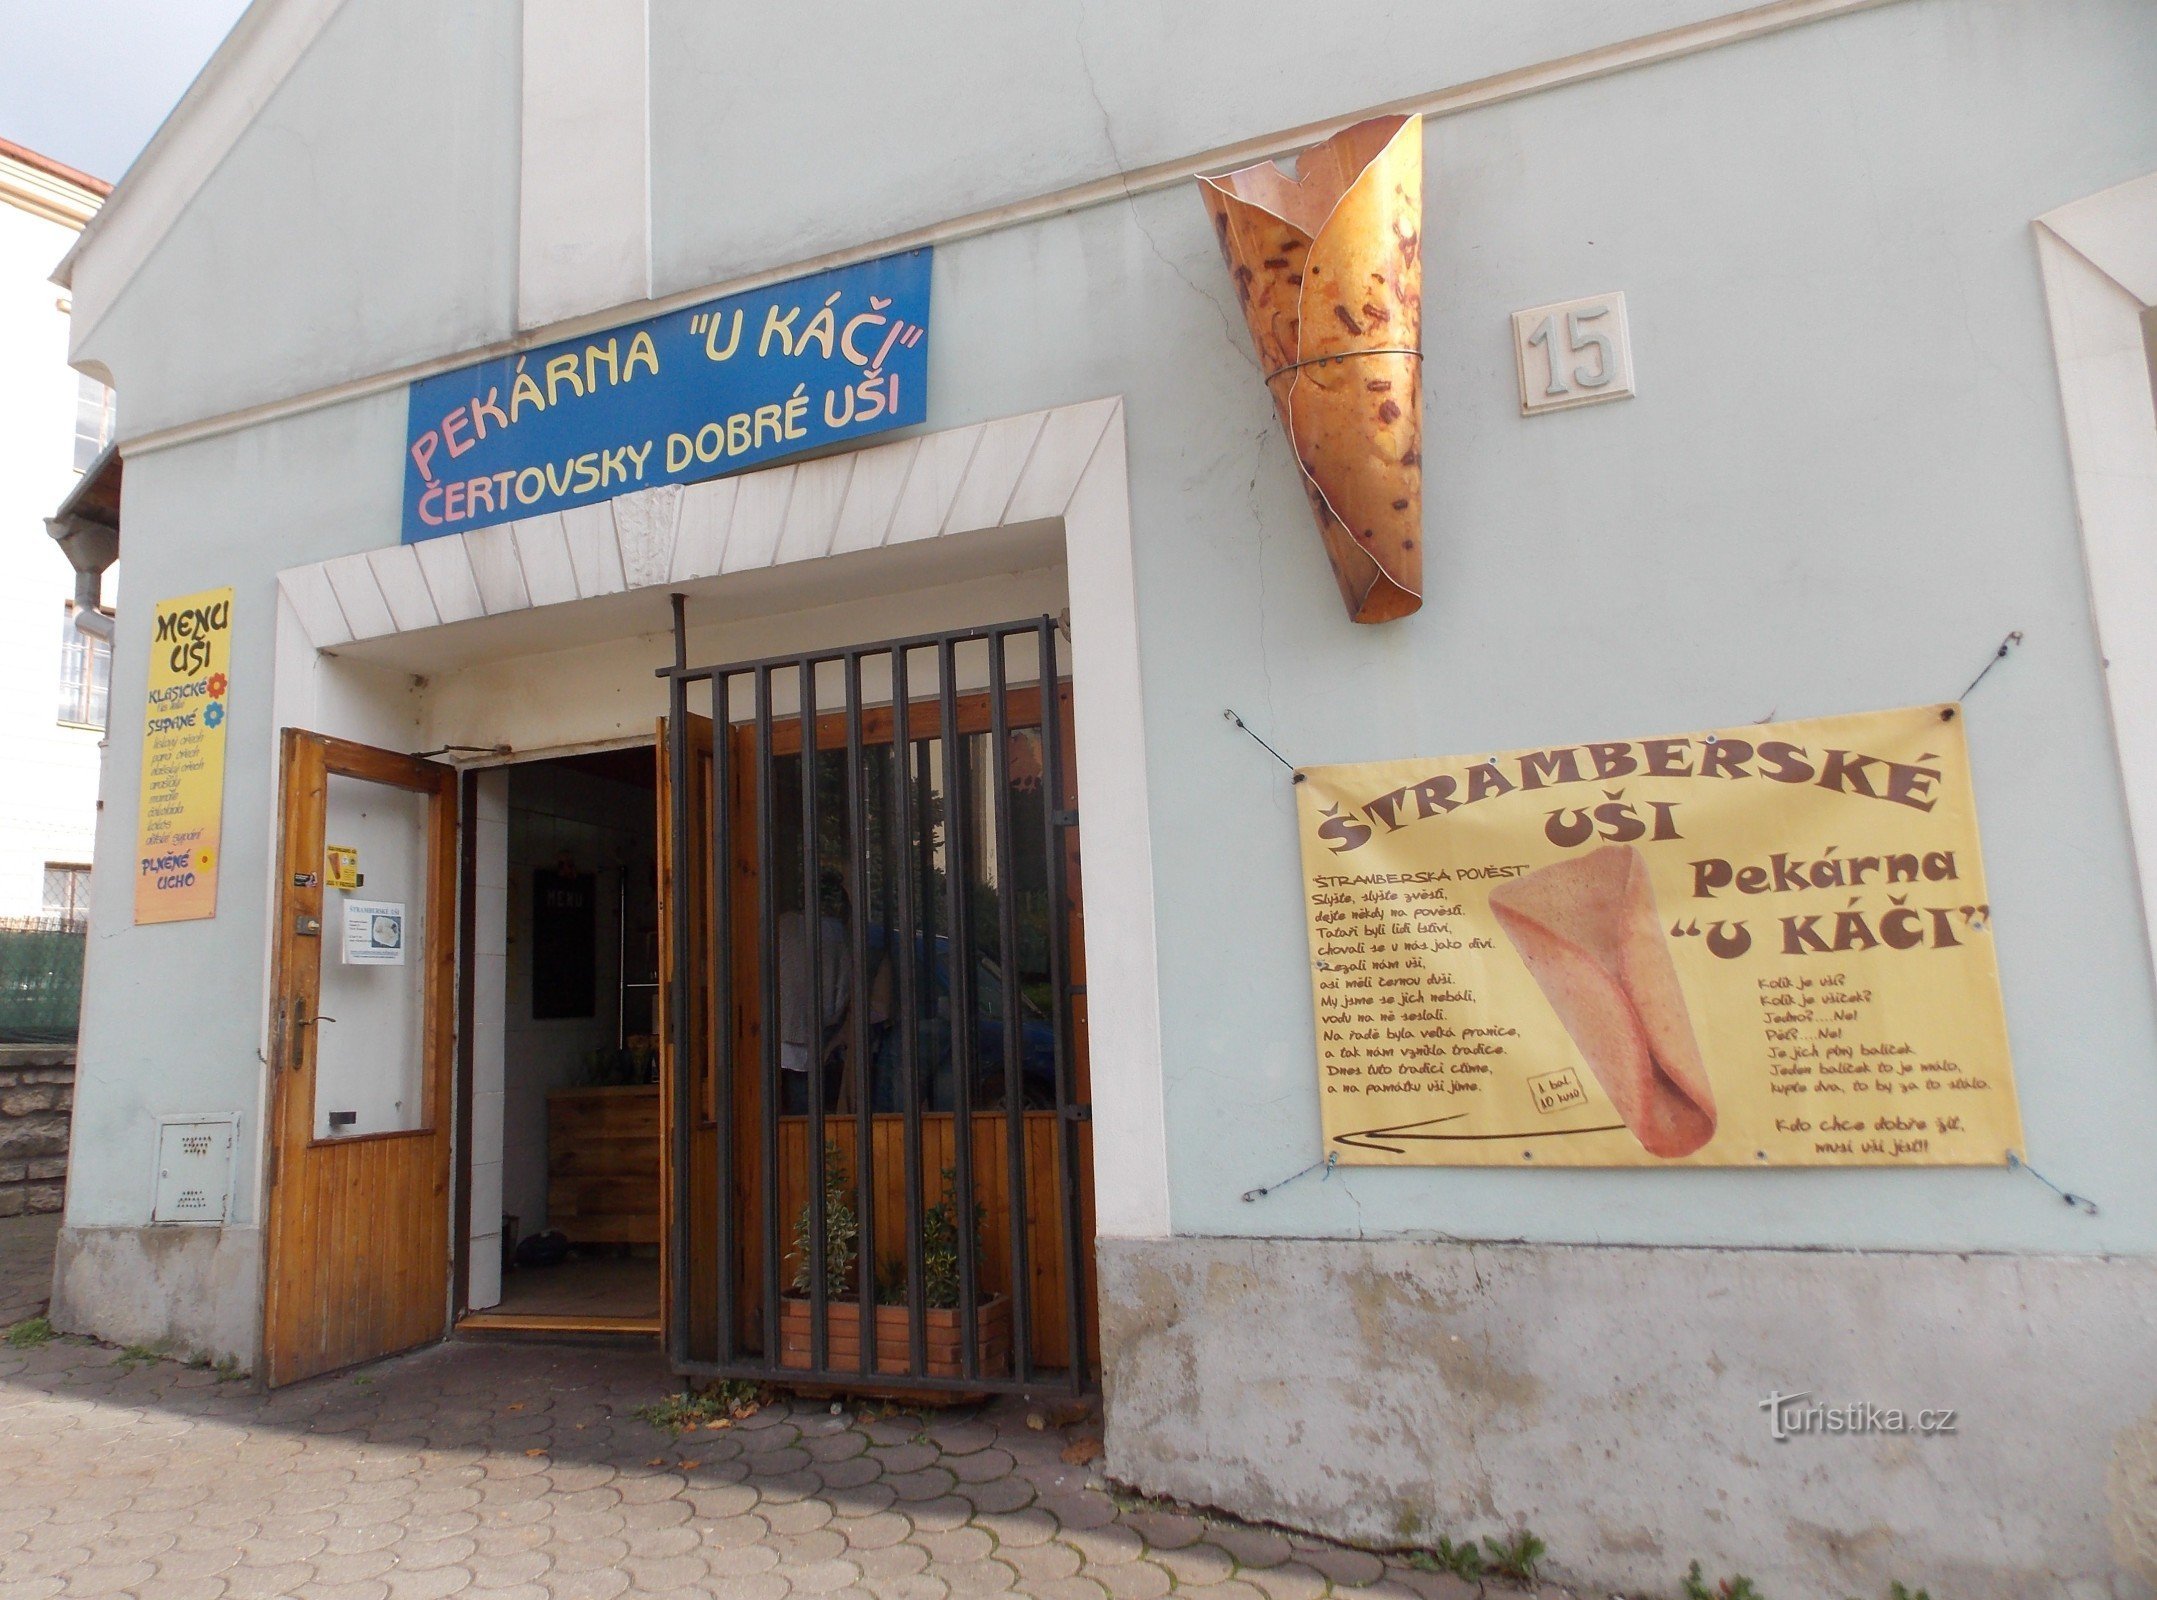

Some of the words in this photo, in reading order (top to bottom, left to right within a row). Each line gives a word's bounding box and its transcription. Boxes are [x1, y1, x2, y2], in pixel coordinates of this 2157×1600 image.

[1528, 304, 1615, 394] 15
[411, 331, 659, 481] PEKÁRNA
[690, 308, 743, 361] "U
[758, 291, 924, 370] KÁČI"
[418, 440, 653, 525] ČERTOVSKY
[666, 383, 809, 473] DOBRÉ
[824, 367, 899, 428] UŠI
[155, 600, 229, 643] MENU
[170, 634, 211, 676] UŠI
[149, 677, 207, 704] KLASICKÉ
[147, 708, 198, 736] SYPANÉ
[1317, 738, 1941, 856] ŠTRAMBERSKÉ
[1543, 788, 1685, 848] UŠI
[142, 849, 190, 875] PLNĚNÉ
[157, 872, 196, 890] UCHO
[1688, 846, 1959, 898] Pekárna
[1311, 893, 1355, 907] Slyšte,
[1361, 890, 1398, 903] slyšte
[1315, 910, 1346, 924] dejte
[1351, 907, 1384, 920] někdy
[1391, 908, 1407, 917] na
[1414, 904, 1466, 919] pověsti.
[1316, 926, 1358, 938] Tataři
[1364, 924, 1386, 938] byli
[1670, 918, 1751, 959] “U
[1778, 893, 1989, 956] KÁČI”
[1318, 942, 1365, 956] chovali
[1370, 944, 1386, 953] se
[1391, 943, 1398, 951] u
[1404, 941, 1428, 951] nás
[1431, 938, 1462, 952] jako
[1372, 959, 1399, 970] nám
[1405, 957, 1425, 969] uši,
[1320, 978, 1339, 989] asi
[1345, 976, 1372, 988] měli
[1378, 976, 1420, 987] černou
[1427, 973, 1455, 985] duši.
[1758, 976, 1793, 989] Kolik
[1796, 976, 1813, 990] je
[1321, 995, 1338, 1009] My
[1341, 994, 1374, 1009] jsme
[1379, 996, 1395, 1005] se
[1398, 990, 1424, 1006] jich
[1430, 989, 1476, 1003] nebáli,
[1760, 994, 1795, 1006] Kolik
[1798, 993, 1815, 1007] je
[1322, 1012, 1351, 1023] vodu
[1357, 1013, 1374, 1022] na
[1380, 1010, 1395, 1021] ně
[1400, 1009, 1447, 1021] seslali.
[1323, 1030, 1343, 1041] Na
[1386, 1027, 1414, 1041] byla
[1420, 1026, 1456, 1038] velká
[1462, 1025, 1520, 1040] pranice,
[1325, 1050, 1335, 1058] a
[1340, 1046, 1361, 1057] tak
[1366, 1046, 1394, 1057] nám
[1400, 1044, 1447, 1059] vznikla
[1452, 1043, 1508, 1055] tradice.
[1767, 1047, 1787, 1058] Je
[1789, 1043, 1819, 1061] jich
[1326, 1065, 1362, 1076] Dnes
[1367, 1064, 1392, 1074] tuto
[1398, 1062, 1444, 1075] tradici
[1769, 1063, 1812, 1076] Jeden
[1878, 1062, 1893, 1073] to
[1897, 1060, 1914, 1076] je
[1327, 1085, 1337, 1093] a
[1343, 1084, 1360, 1093] na
[1365, 1080, 1421, 1096] památku
[1427, 1080, 1445, 1091] uši
[1770, 1081, 1807, 1096] kupte
[1814, 1080, 1845, 1093] dva,
[1853, 1080, 1869, 1091] to
[1875, 1080, 1892, 1093] by
[1900, 1082, 1919, 1093] za
[1926, 1078, 1941, 1090] to
[1540, 1096, 1554, 1110] 10
[1775, 1117, 1811, 1133] Kdo
[1819, 1115, 1865, 1131] chce
[1874, 1116, 1926, 1131] dobře
